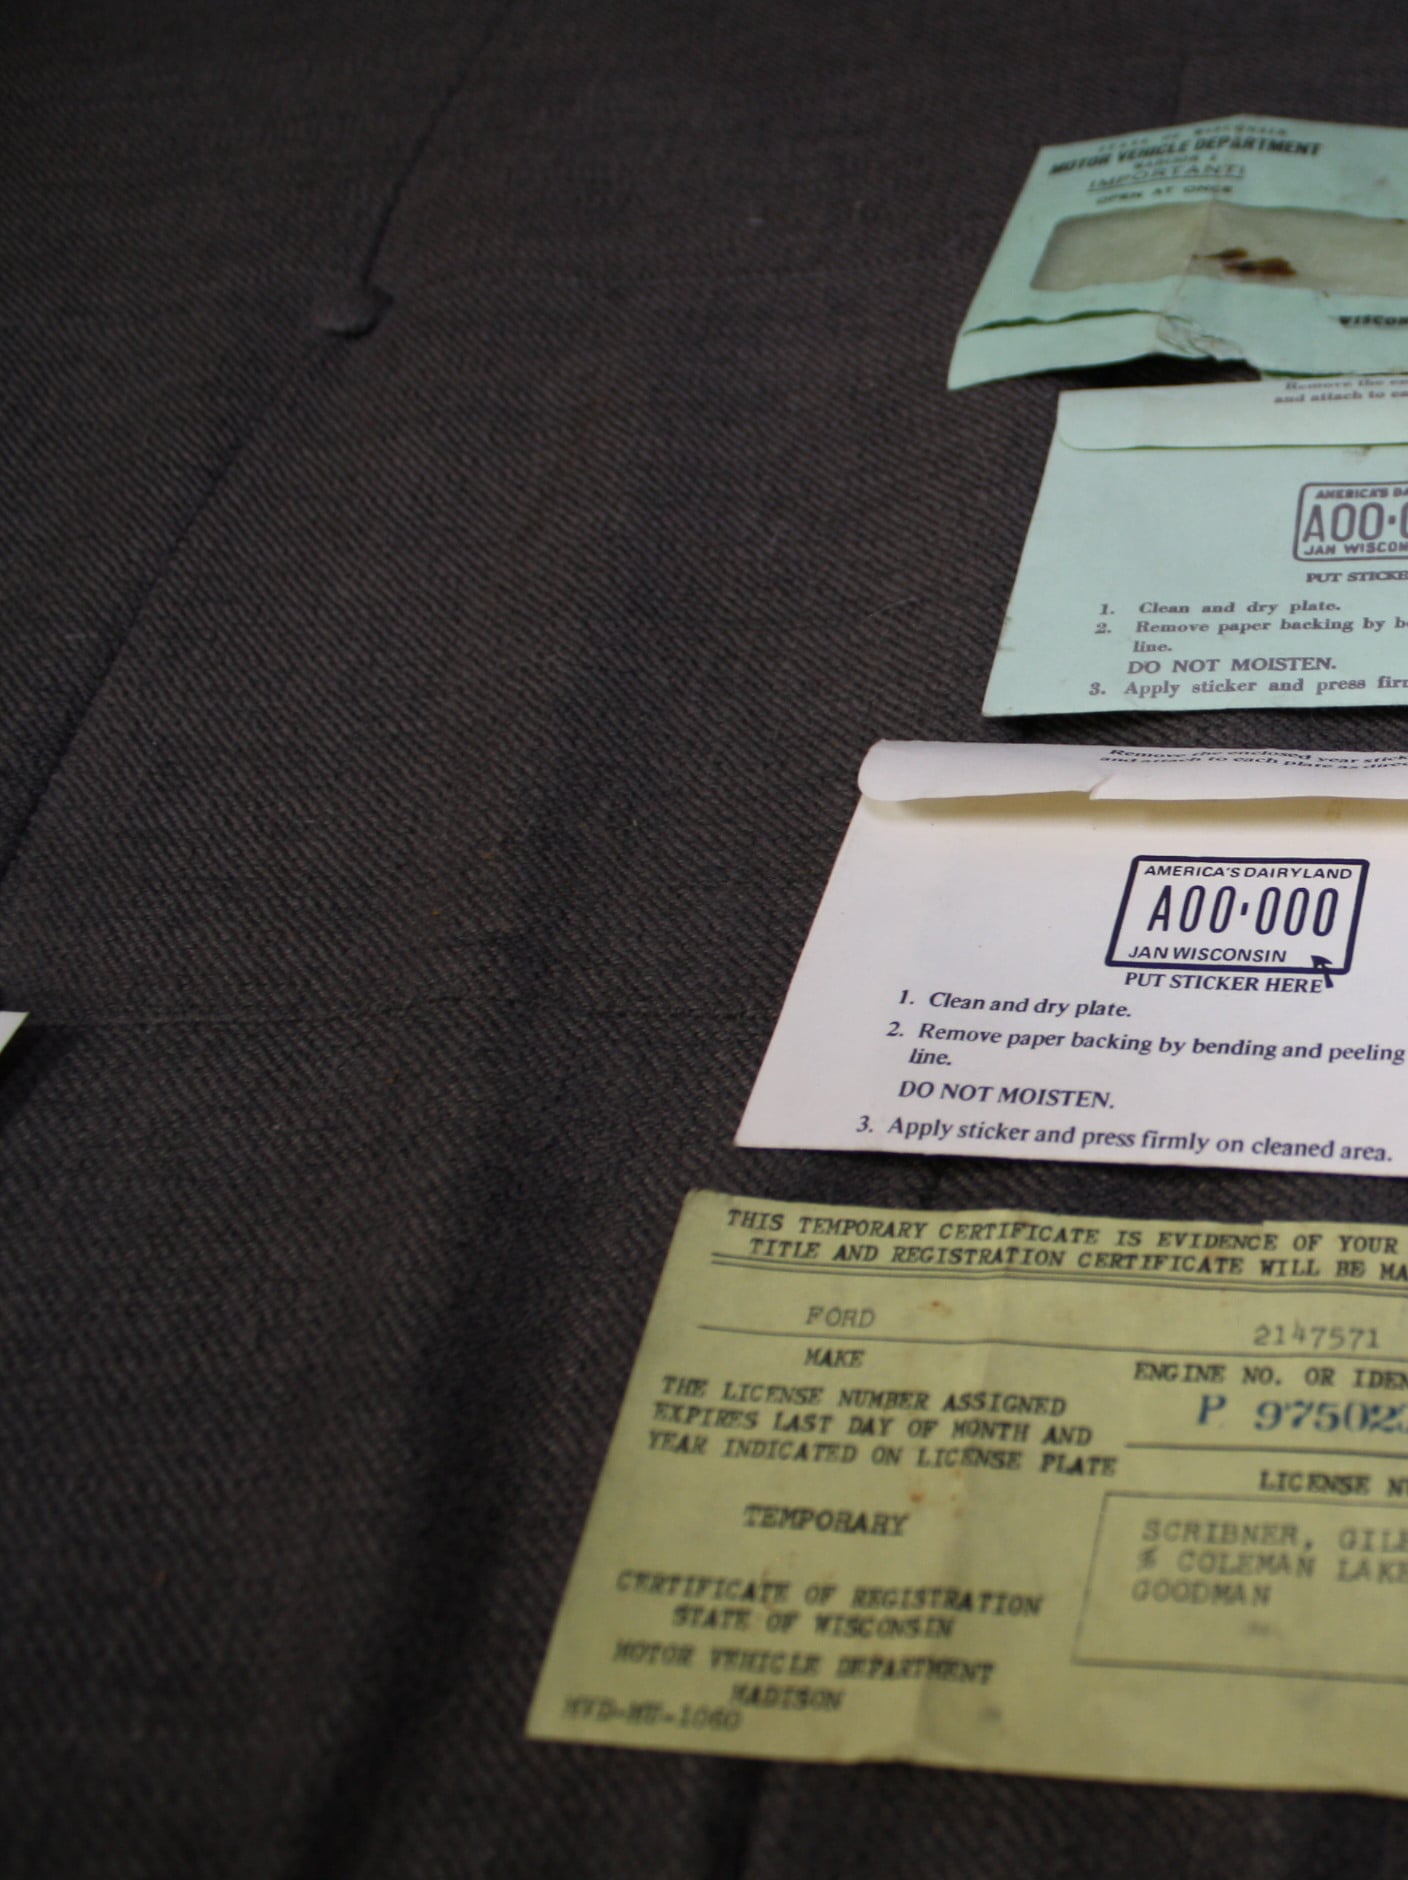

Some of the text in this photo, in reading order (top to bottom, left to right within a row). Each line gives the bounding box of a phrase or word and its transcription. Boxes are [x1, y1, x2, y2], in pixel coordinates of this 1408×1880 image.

[1049, 156, 1109, 175] MOTOR
[1118, 138, 1187, 164] VEHICLE
[1195, 137, 1323, 157] DEPARTMENT
[1315, 488, 1388, 499] AMERICA'S
[1304, 544, 1336, 556] JAN
[1306, 573, 1342, 583] PUT
[1100, 601, 1340, 615] 1. Clean and dry plate.
[1127, 657, 1336, 674] DO NOT MOISTEN.
[1089, 682, 1106, 695] 3.
[1124, 681, 1180, 699] Apply
[1192, 679, 1257, 693] sticker
[1269, 679, 1304, 692] and
[1316, 679, 1366, 695] press
[1144, 865, 1352, 880] AMERICA'S DAIRYLAND
[1129, 947, 1286, 963] JAN WISCONSIN
[1124, 971, 1322, 993] PUT STICKER HERE
[898, 990, 1132, 1018] 1. Clean and dry plate.
[886, 1021, 904, 1037] 2.
[918, 1023, 1002, 1044] Remove
[1006, 1031, 1066, 1049] paper
[1071, 1032, 1152, 1055] backing
[1158, 1037, 1186, 1056] by
[1192, 1038, 1277, 1060] bending
[1282, 1043, 1323, 1059] and
[1328, 1044, 1405, 1066] peeling
[908, 1048, 952, 1066] line.
[898, 1081, 1114, 1109] DO NOT MOISTEN.
[727, 1209, 783, 1231] THIS
[798, 1217, 928, 1241] TEMPORARY
[939, 1224, 1099, 1244] CERTIFICATE
[1116, 1231, 1142, 1247] IS
[1158, 1232, 1277, 1252] EVIDENCE
[1293, 1234, 1322, 1253] OF
[1339, 1236, 1398, 1255] YOUR
[806, 1307, 1379, 1349] FORD 2147571
[805, 1348, 864, 1368] MAKE
[1259, 1471, 1371, 1494] LICENSE
[1142, 1519, 1315, 1551] SCRIBNER,
[1177, 1550, 1316, 1578] COLEMAN
[1132, 1579, 1272, 1608] GOODMAN
